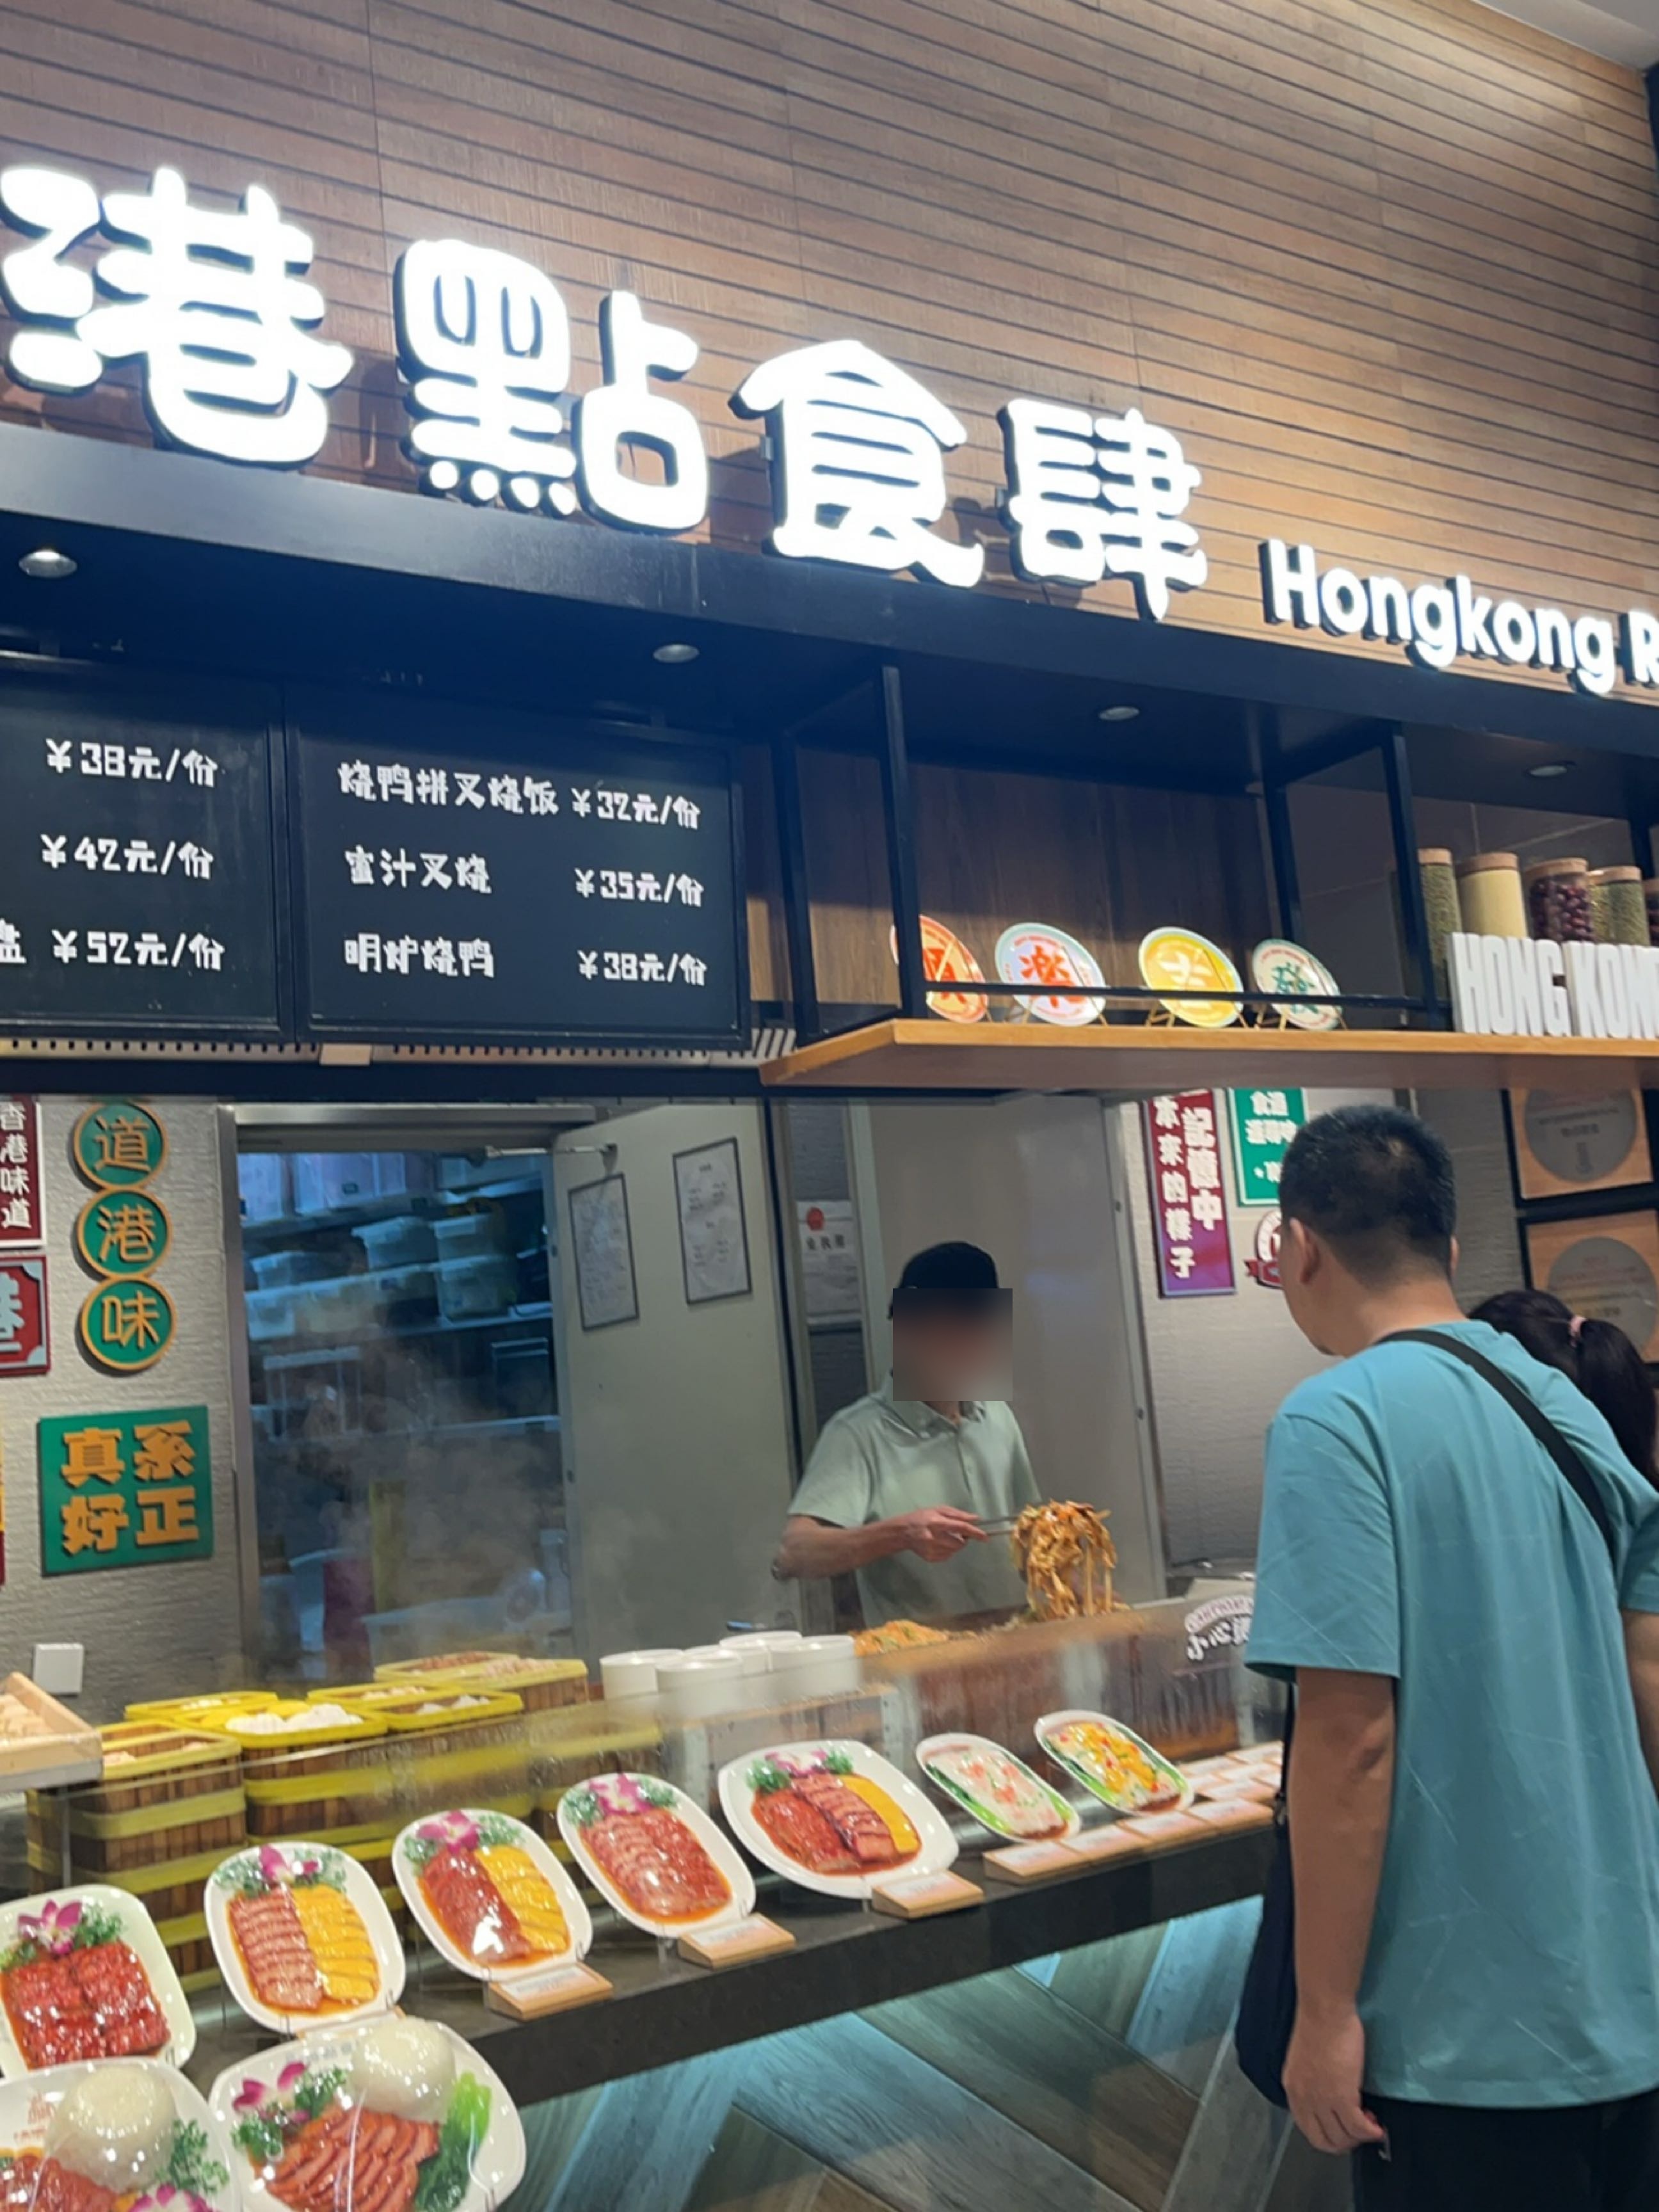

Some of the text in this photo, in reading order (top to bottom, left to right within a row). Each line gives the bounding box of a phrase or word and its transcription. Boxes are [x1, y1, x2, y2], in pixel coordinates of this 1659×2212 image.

[0, 165, 1208, 621] 港點食肆
[1262, 538, 1616, 696] Hongkong
[346, 845, 491, 893] 蜜汁叉烧
[345, 934, 493, 977] 明炉烧鸭
[1447, 932, 1571, 1036] HONG
[93, 1116, 161, 1350] 道港味
[61, 1420, 196, 1488] 真系
[61, 1486, 200, 1556] 好正
